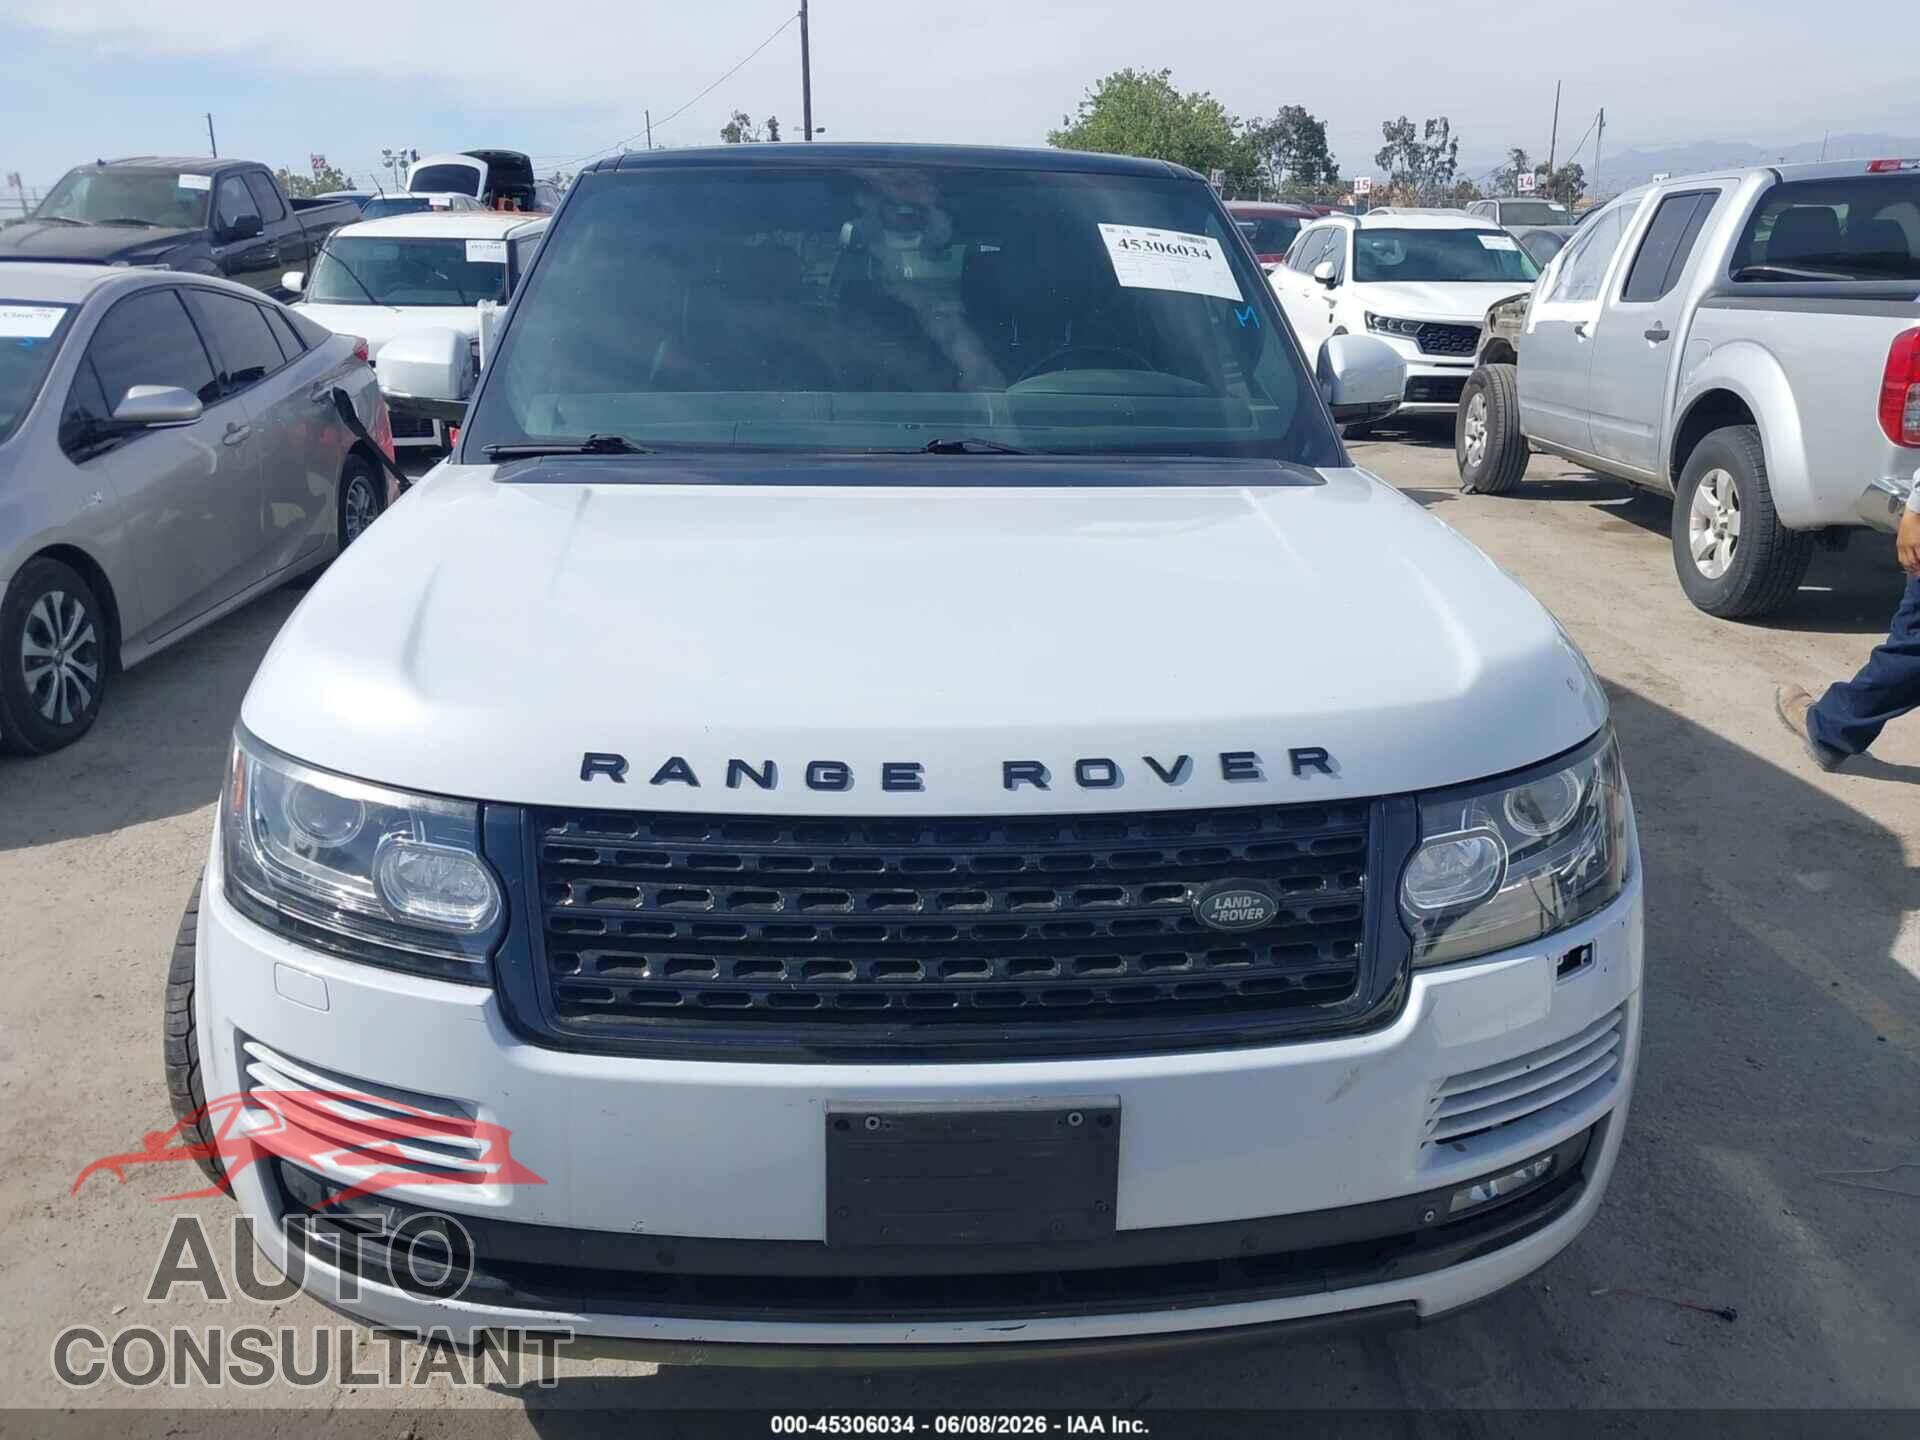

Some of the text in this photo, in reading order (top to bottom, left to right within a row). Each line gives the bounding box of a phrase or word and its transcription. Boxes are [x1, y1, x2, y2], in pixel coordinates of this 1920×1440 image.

[312, 158, 326, 169] 22
[1355, 179, 1370, 191] 15
[1520, 175, 1533, 187] 14
[1117, 237, 1212, 261] 45306034
[580, 746, 1336, 793] RANGE ROVER
[1214, 895, 1252, 910] LAND
[1218, 907, 1264, 922] ROVER
